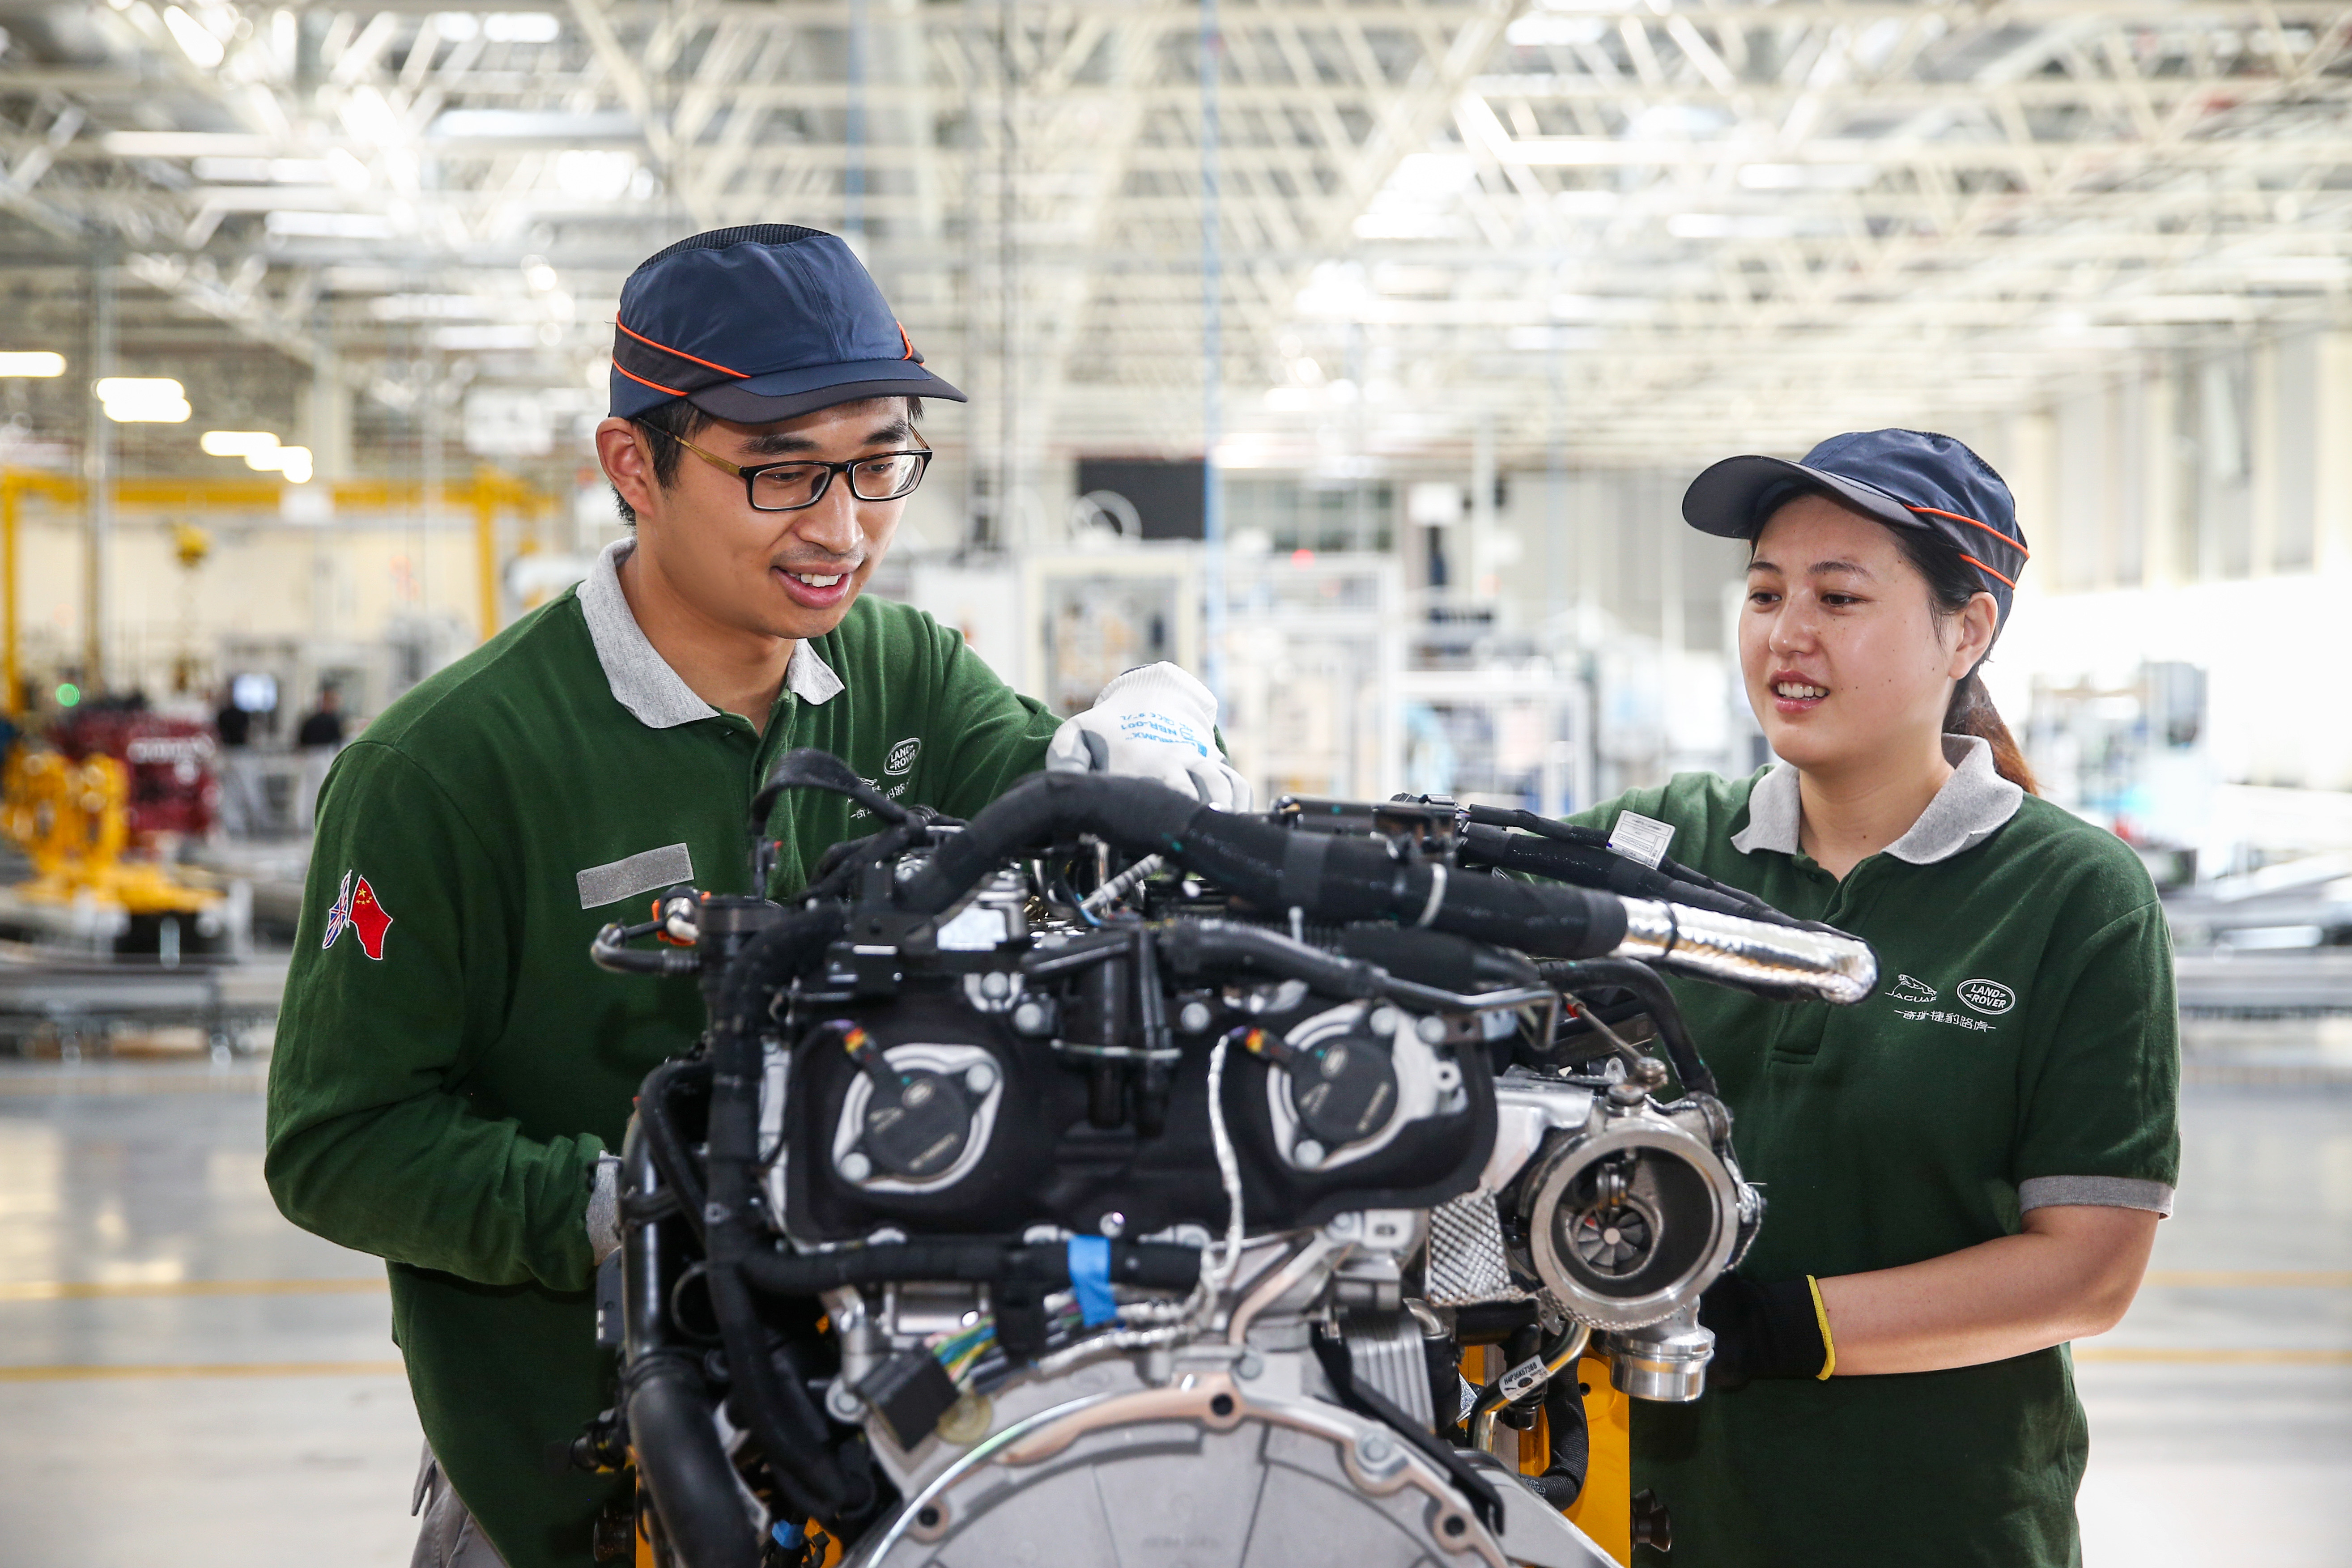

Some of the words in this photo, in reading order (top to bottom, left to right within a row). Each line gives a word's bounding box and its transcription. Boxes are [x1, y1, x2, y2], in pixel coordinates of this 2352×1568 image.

[1884, 990, 1937, 1003] JAGUAR
[1970, 984, 2002, 998] LAND
[1969, 995, 2007, 1008] ROVER
